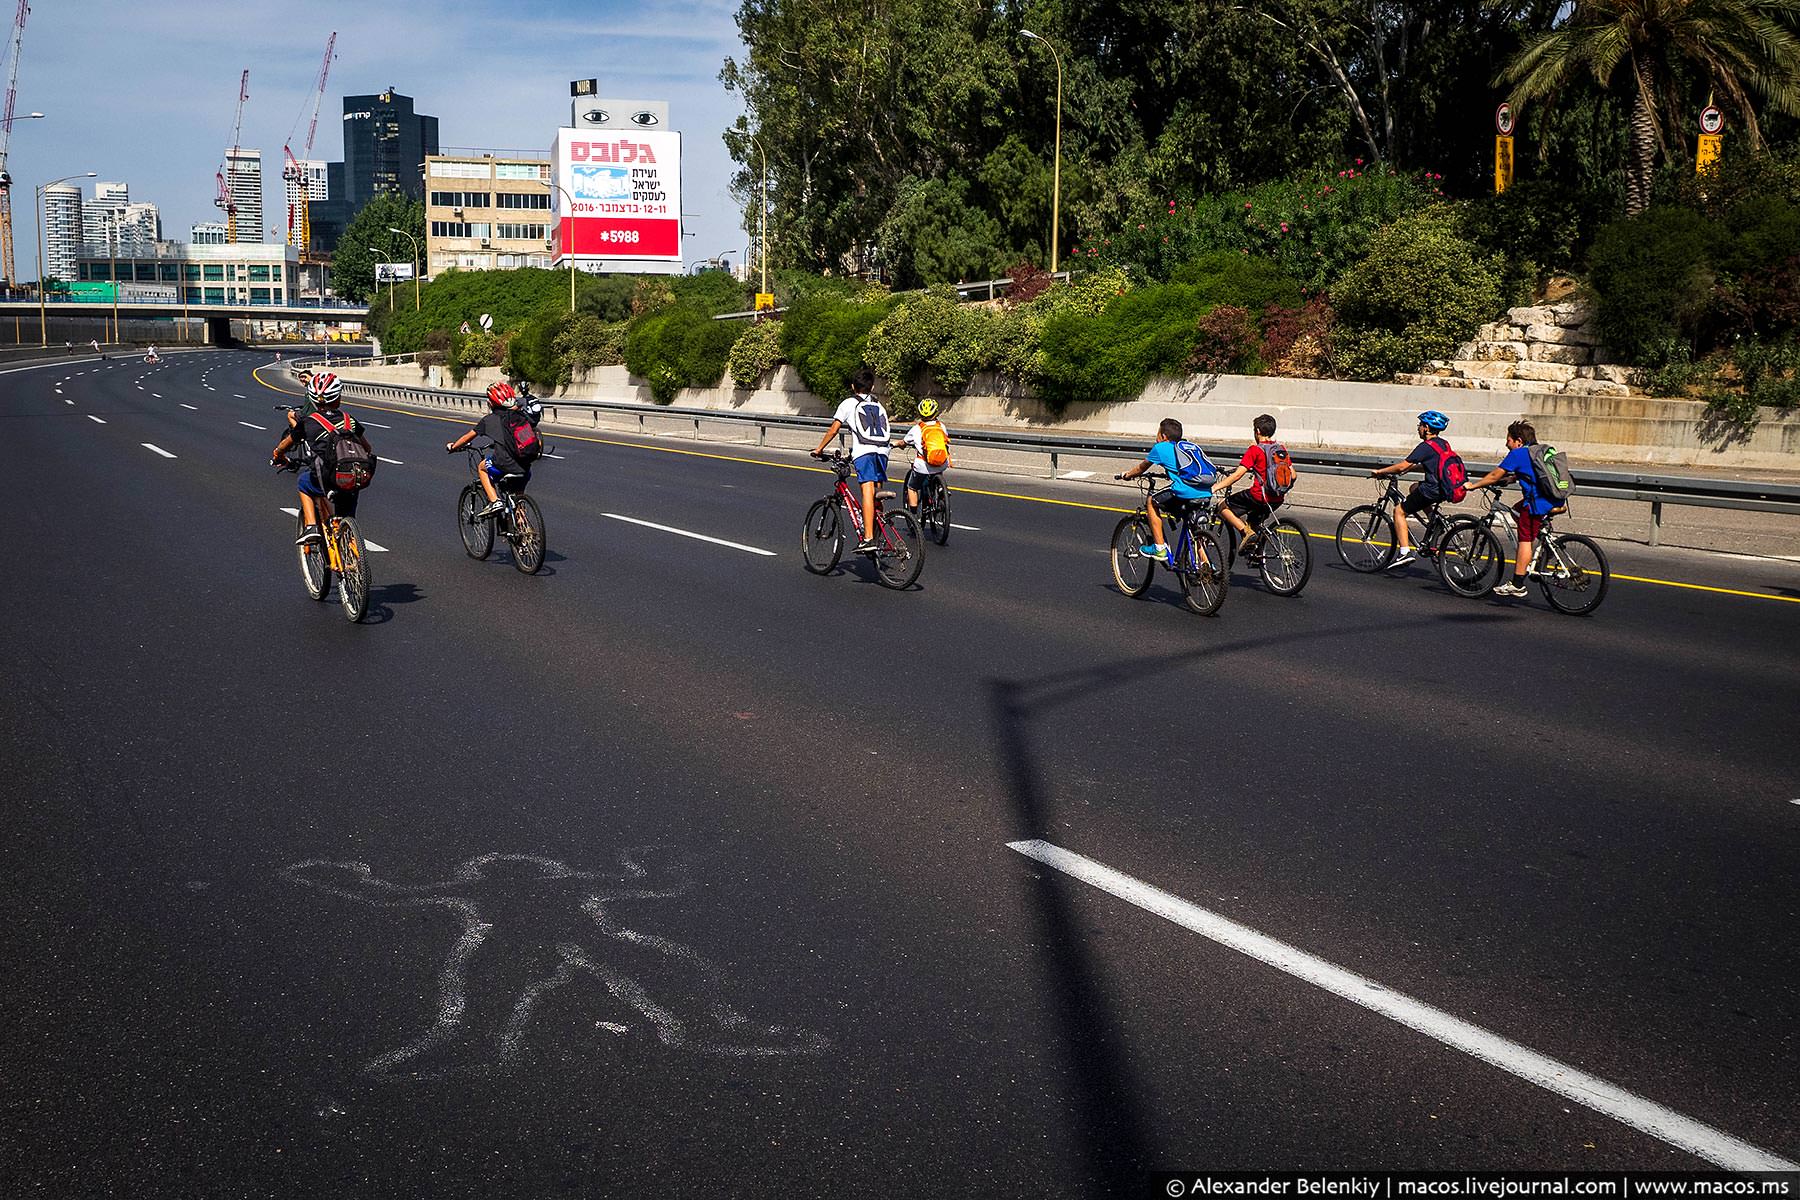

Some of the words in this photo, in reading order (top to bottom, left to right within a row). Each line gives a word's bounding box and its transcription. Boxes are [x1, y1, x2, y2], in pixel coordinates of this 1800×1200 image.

[571, 139, 657, 164] גלובס
[632, 168, 657, 178] ועידת
[632, 179, 661, 190] ישראל
[632, 191, 666, 202] לעסקים
